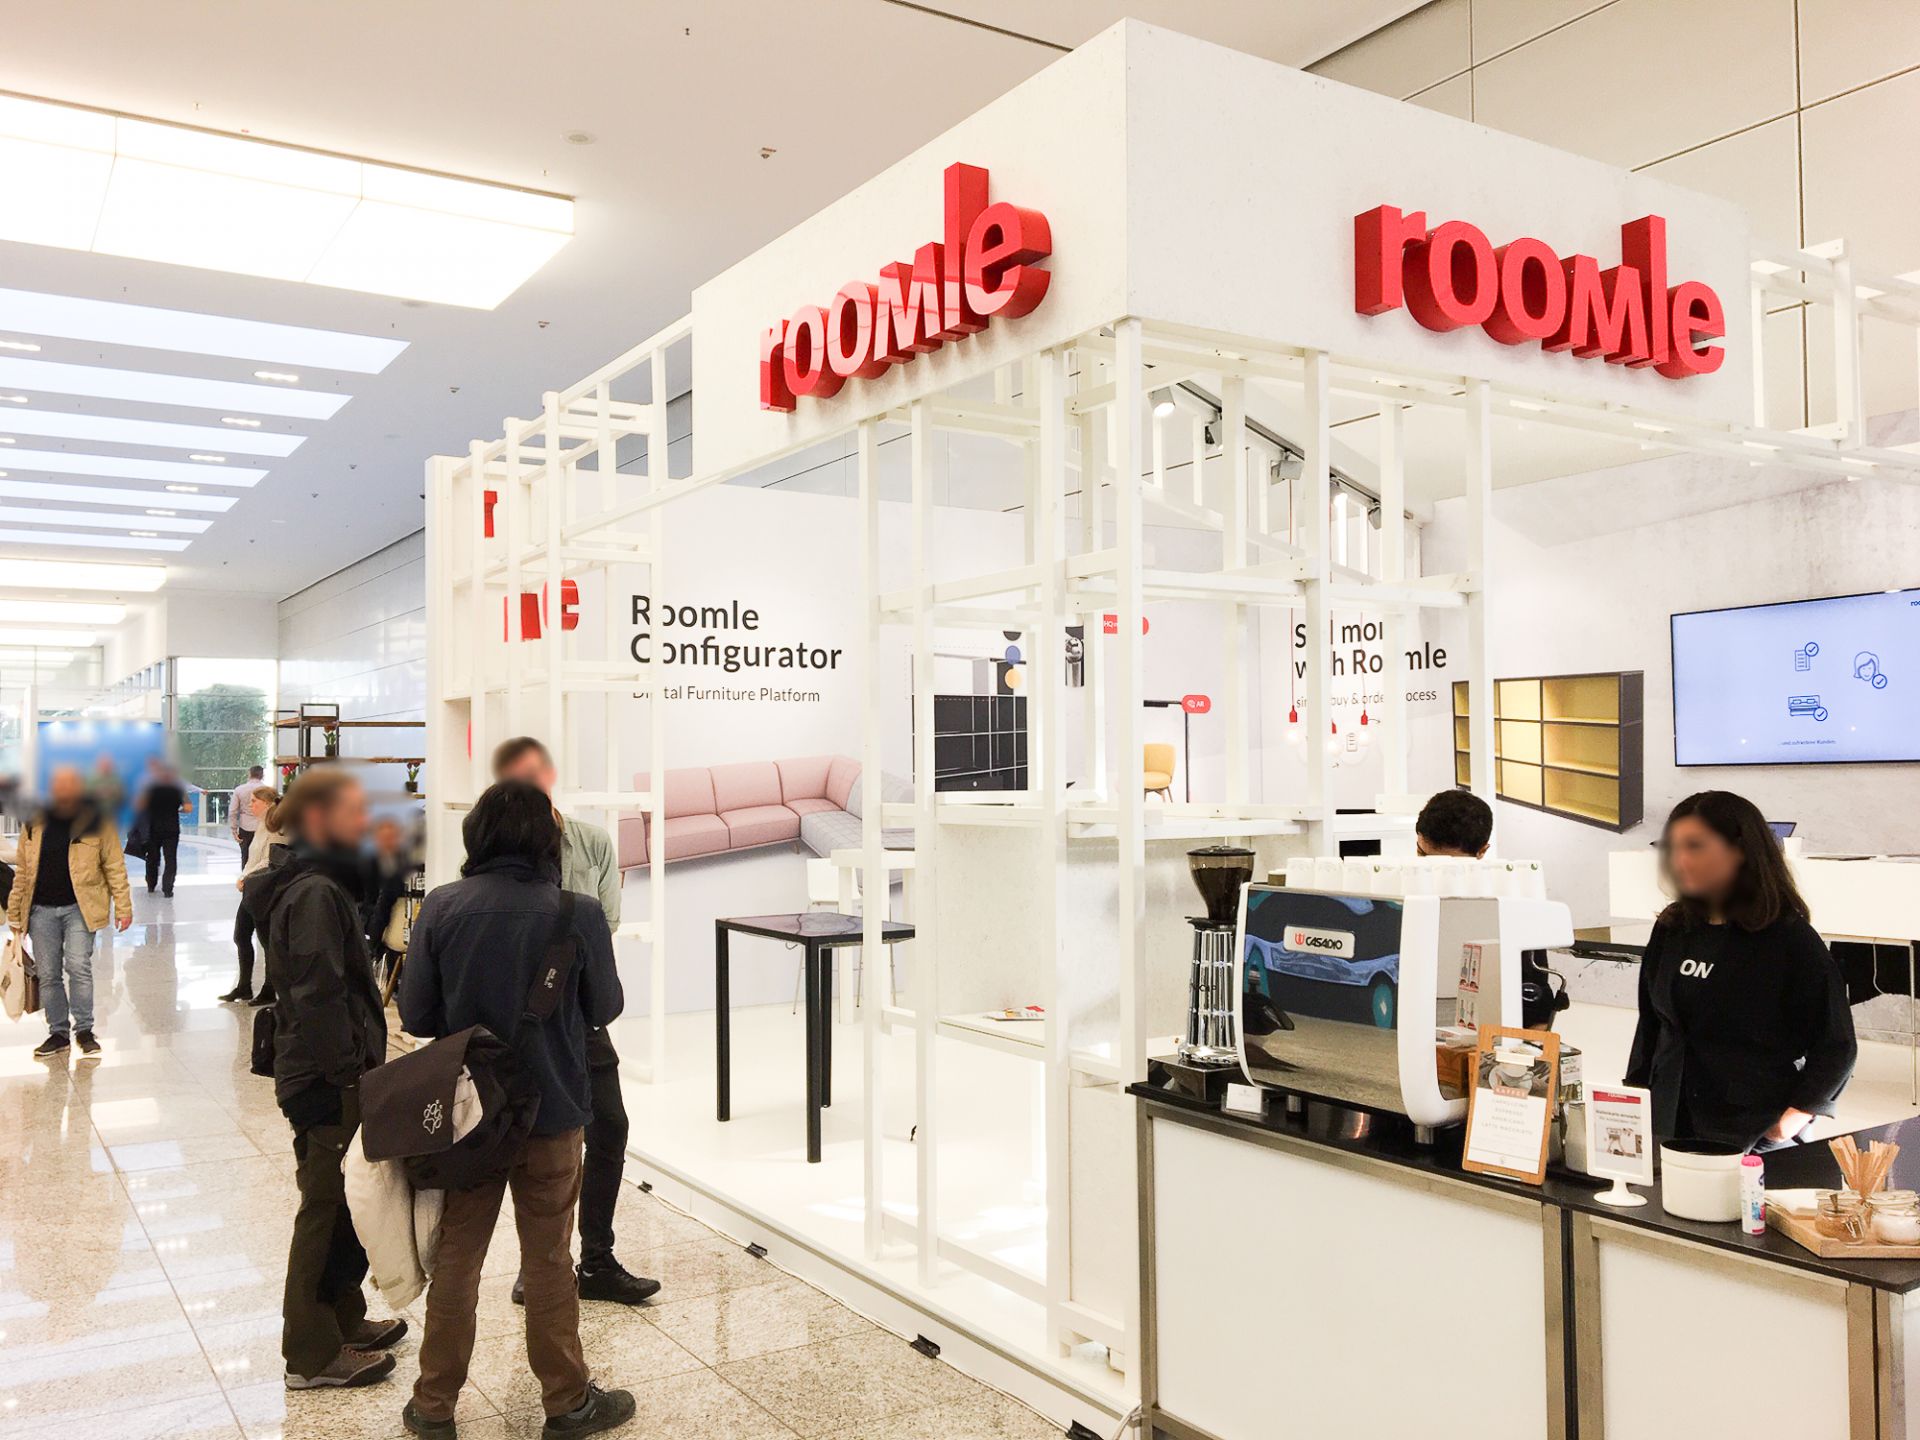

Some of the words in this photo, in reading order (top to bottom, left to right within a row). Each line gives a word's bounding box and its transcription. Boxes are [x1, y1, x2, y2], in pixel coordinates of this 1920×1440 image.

[760, 161, 1052, 413] roomle
[1354, 204, 1726, 380] roomle
[632, 594, 759, 631] Roomle
[1294, 619, 1334, 649] Sl
[1342, 621, 1383, 644] mo
[630, 633, 843, 673] Configurator
[1353, 641, 1447, 675] Romle
[687, 685, 756, 701] Furniture
[760, 687, 820, 702] Platform
[1405, 689, 1437, 702] ocess
[1305, 936, 1343, 950] CASADIO
[1679, 959, 1714, 979] ON
